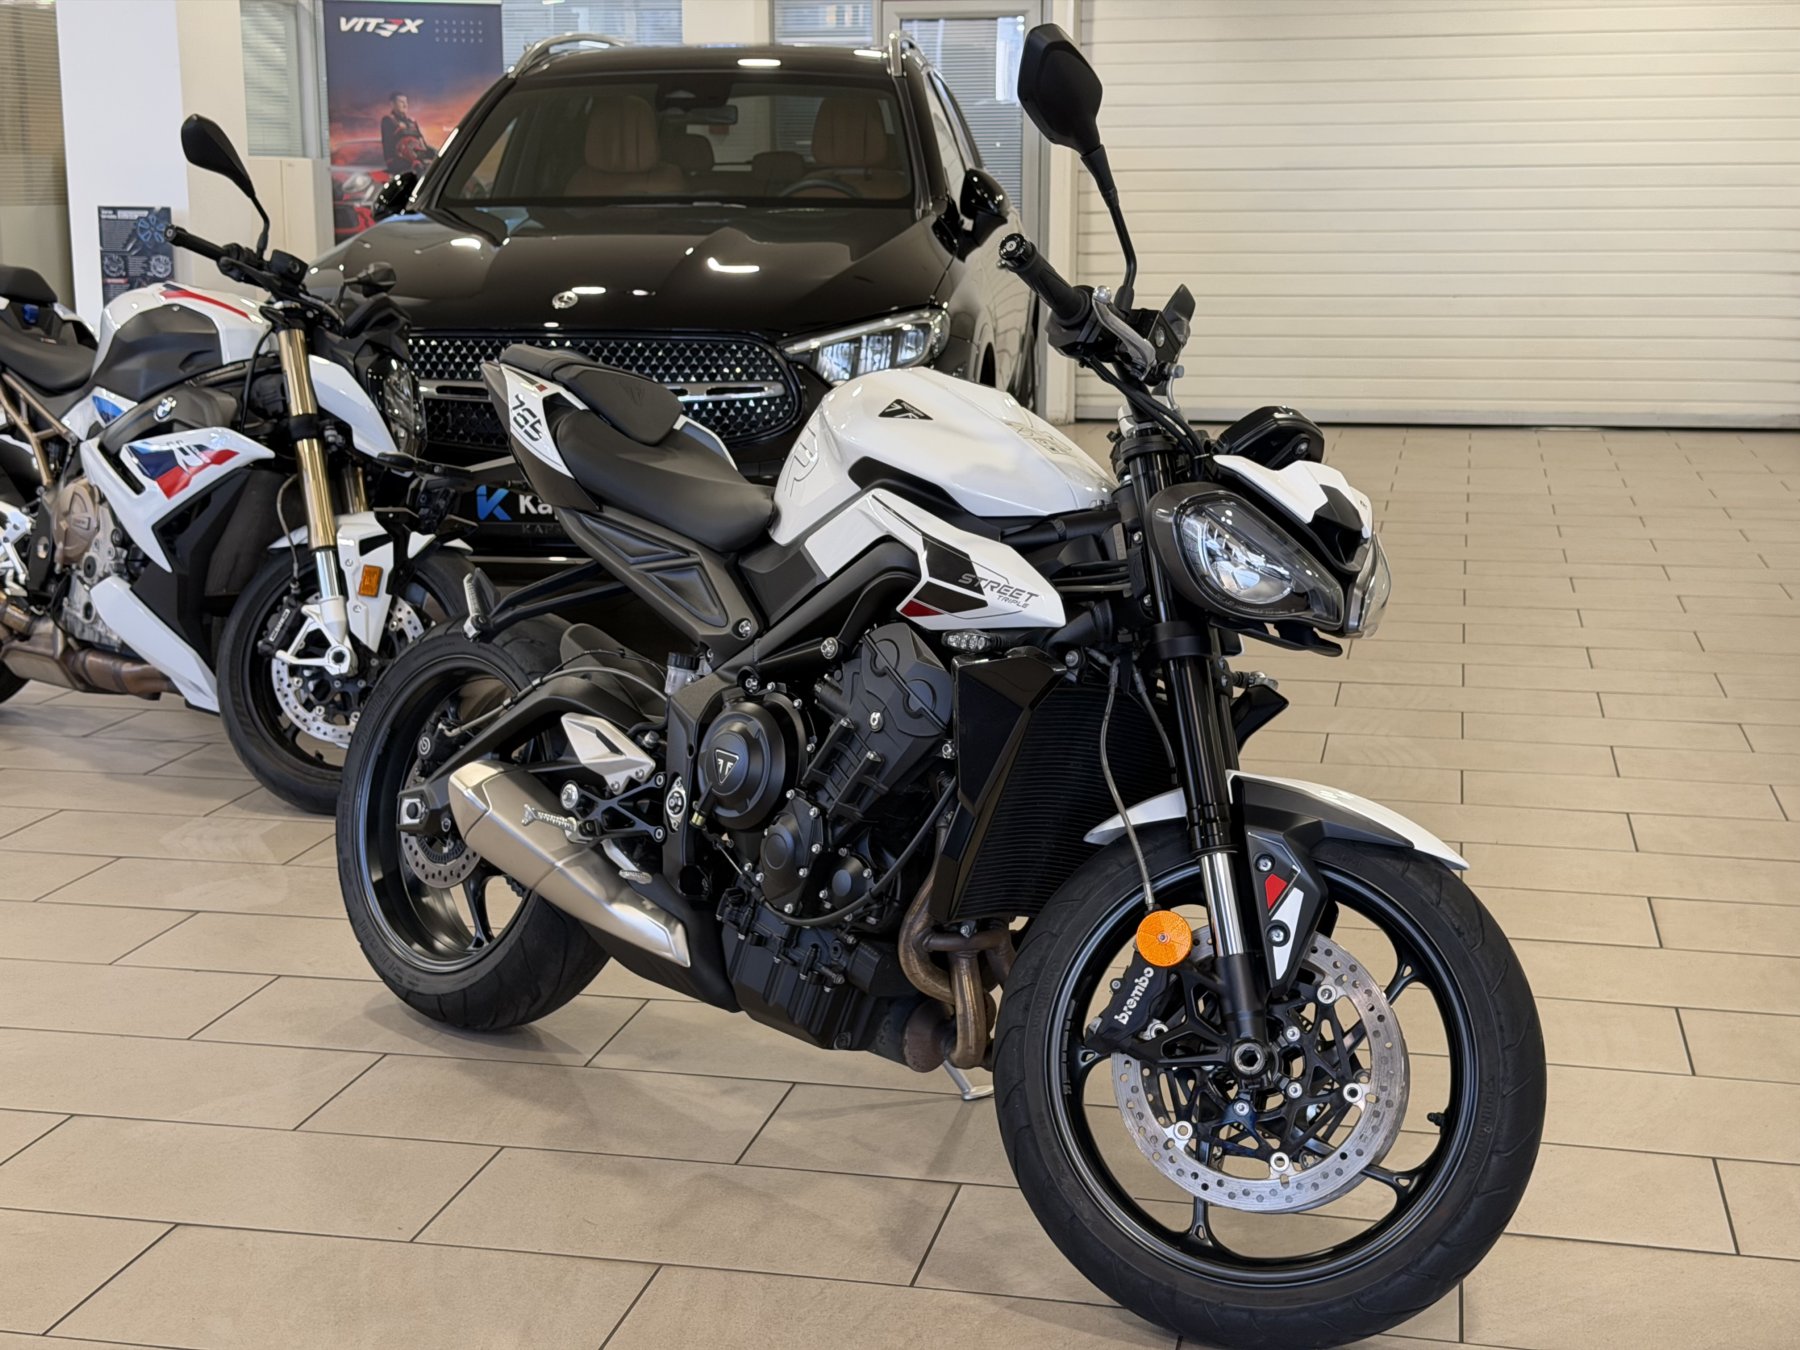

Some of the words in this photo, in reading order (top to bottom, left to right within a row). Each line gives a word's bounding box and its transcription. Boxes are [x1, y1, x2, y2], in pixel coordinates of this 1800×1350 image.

[511, 393, 543, 442] 765
[958, 572, 1040, 603] STREET
[997, 595, 1030, 609] TRIPLE
[1113, 966, 1155, 1025] brembo
